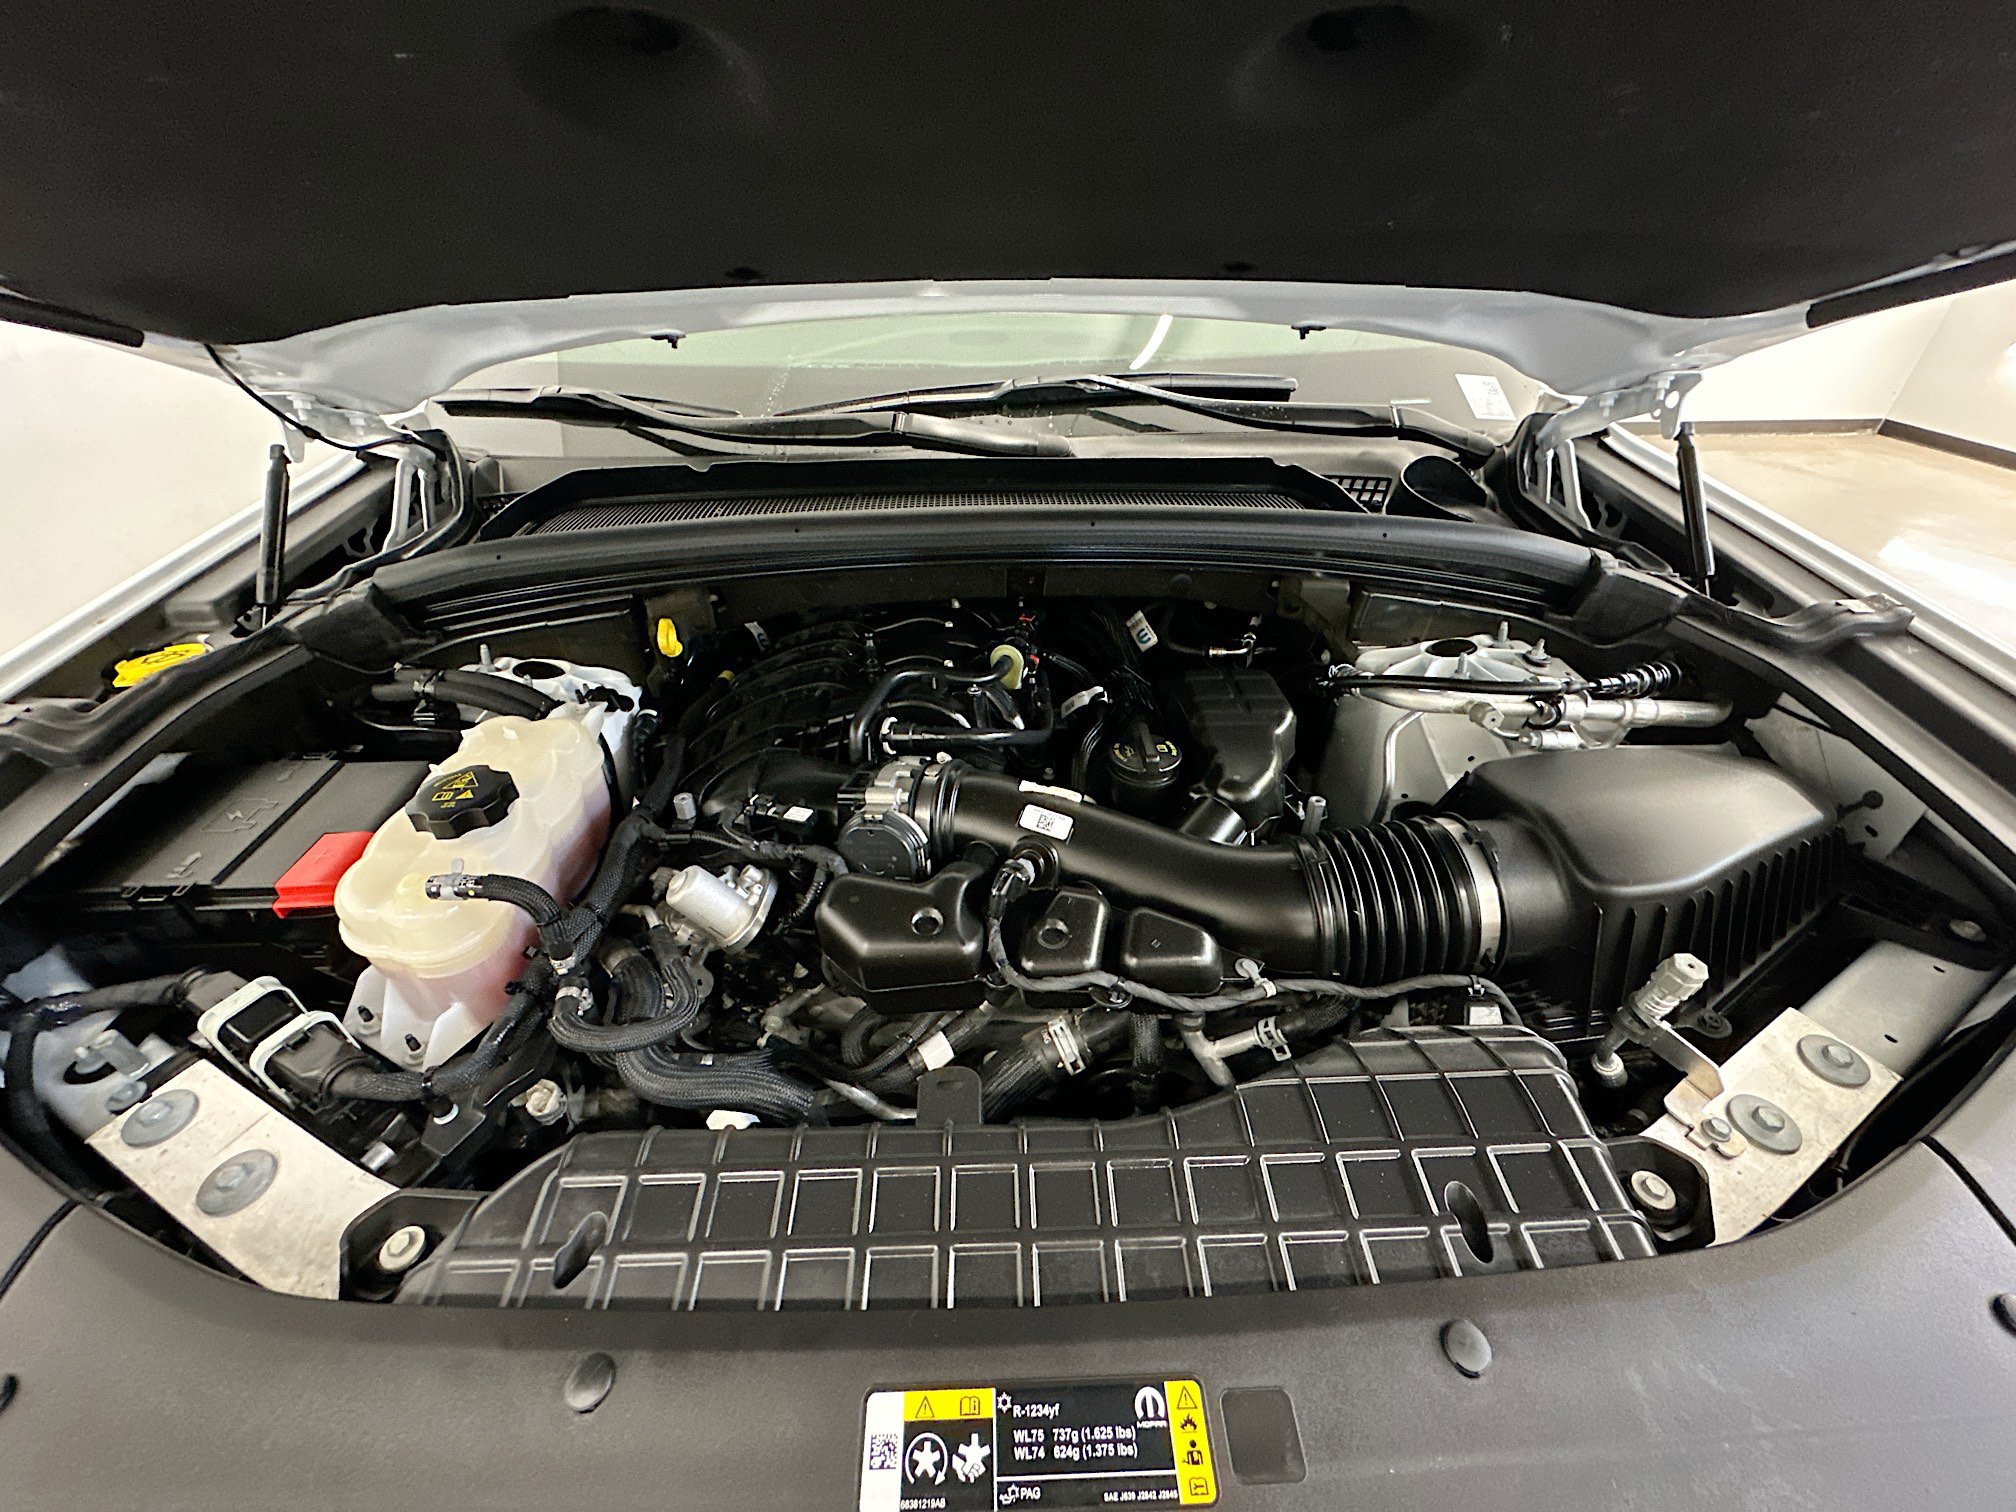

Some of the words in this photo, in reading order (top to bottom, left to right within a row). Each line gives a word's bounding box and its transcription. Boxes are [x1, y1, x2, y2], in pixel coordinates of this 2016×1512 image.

[1012, 1402, 1060, 1419] R-1234yf
[1013, 1429, 1045, 1443] WL75
[1052, 1427, 1079, 1443] 737g
[1081, 1426, 1113, 1441] (1.625
[1115, 1425, 1137, 1440] lbs)
[1014, 1446, 1046, 1460] WL74
[1082, 1444, 1115, 1460] (1.375
[1117, 1442, 1138, 1459] lbs)
[1020, 1487, 1041, 1500] PAG
